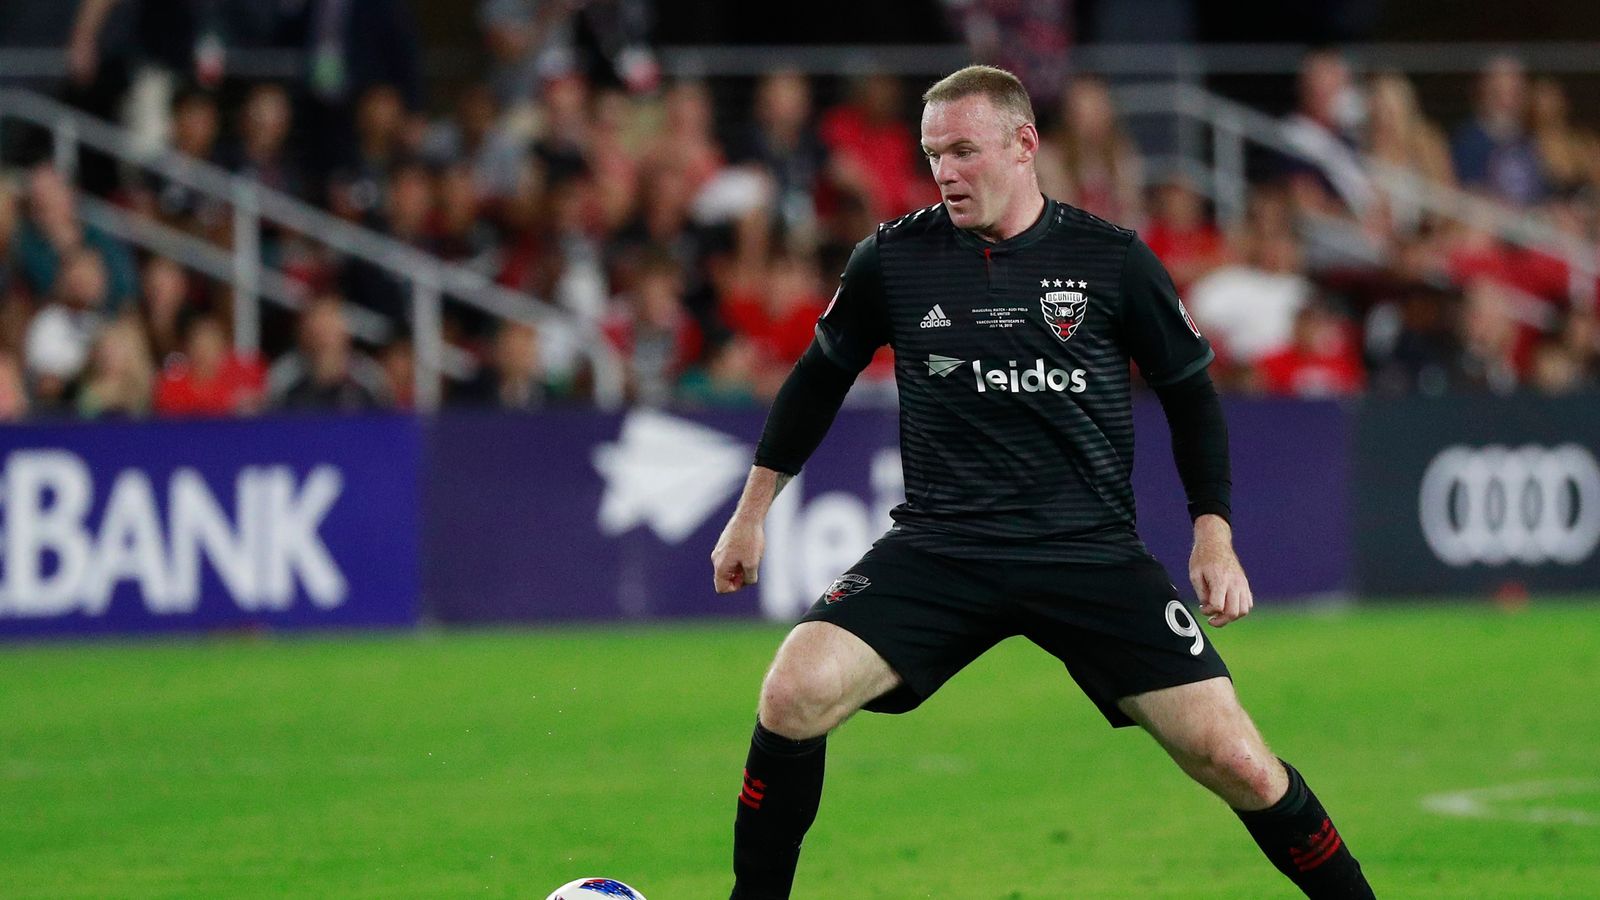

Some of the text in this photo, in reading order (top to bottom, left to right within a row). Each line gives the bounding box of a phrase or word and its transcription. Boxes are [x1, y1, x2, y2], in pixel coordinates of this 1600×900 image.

[920, 317, 952, 329] adidas
[972, 359, 1087, 393] leidos
[0, 448, 349, 617] BANK
[1164, 599, 1205, 656] 9
